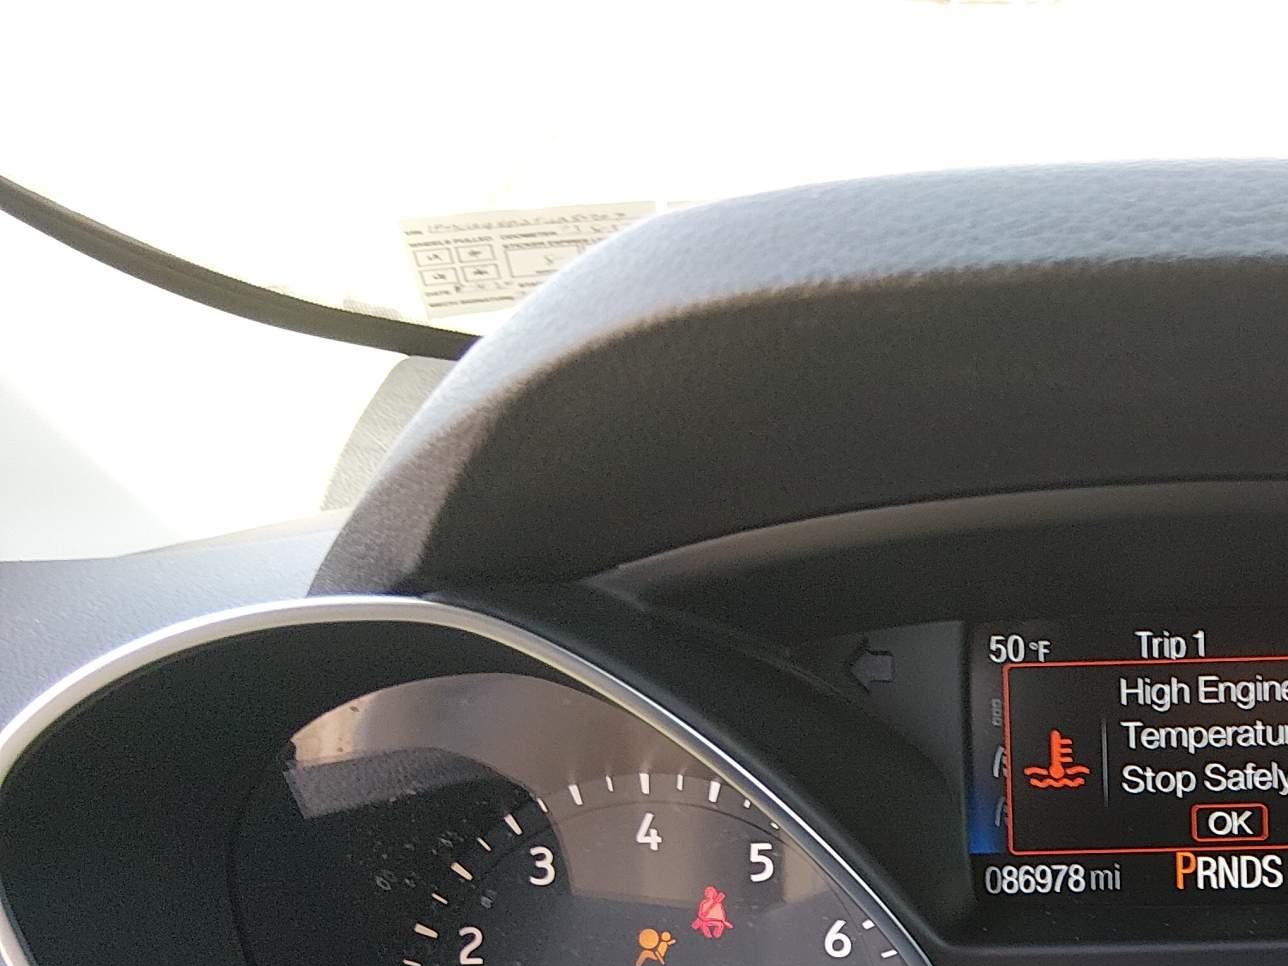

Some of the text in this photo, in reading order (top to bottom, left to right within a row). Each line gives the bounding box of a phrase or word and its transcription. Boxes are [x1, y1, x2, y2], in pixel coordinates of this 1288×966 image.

[1134, 630, 1205, 660] Trip 1
[1120, 676, 1191, 712] High
[1121, 765, 1197, 798] Stop
[636, 812, 662, 851] 4
[1208, 810, 1254, 836] OK
[529, 846, 556, 886] 3
[750, 842, 774, 882] 5
[985, 863, 1121, 894] 086978 mi
[459, 926, 484, 965] 2
[824, 919, 852, 958] 6
